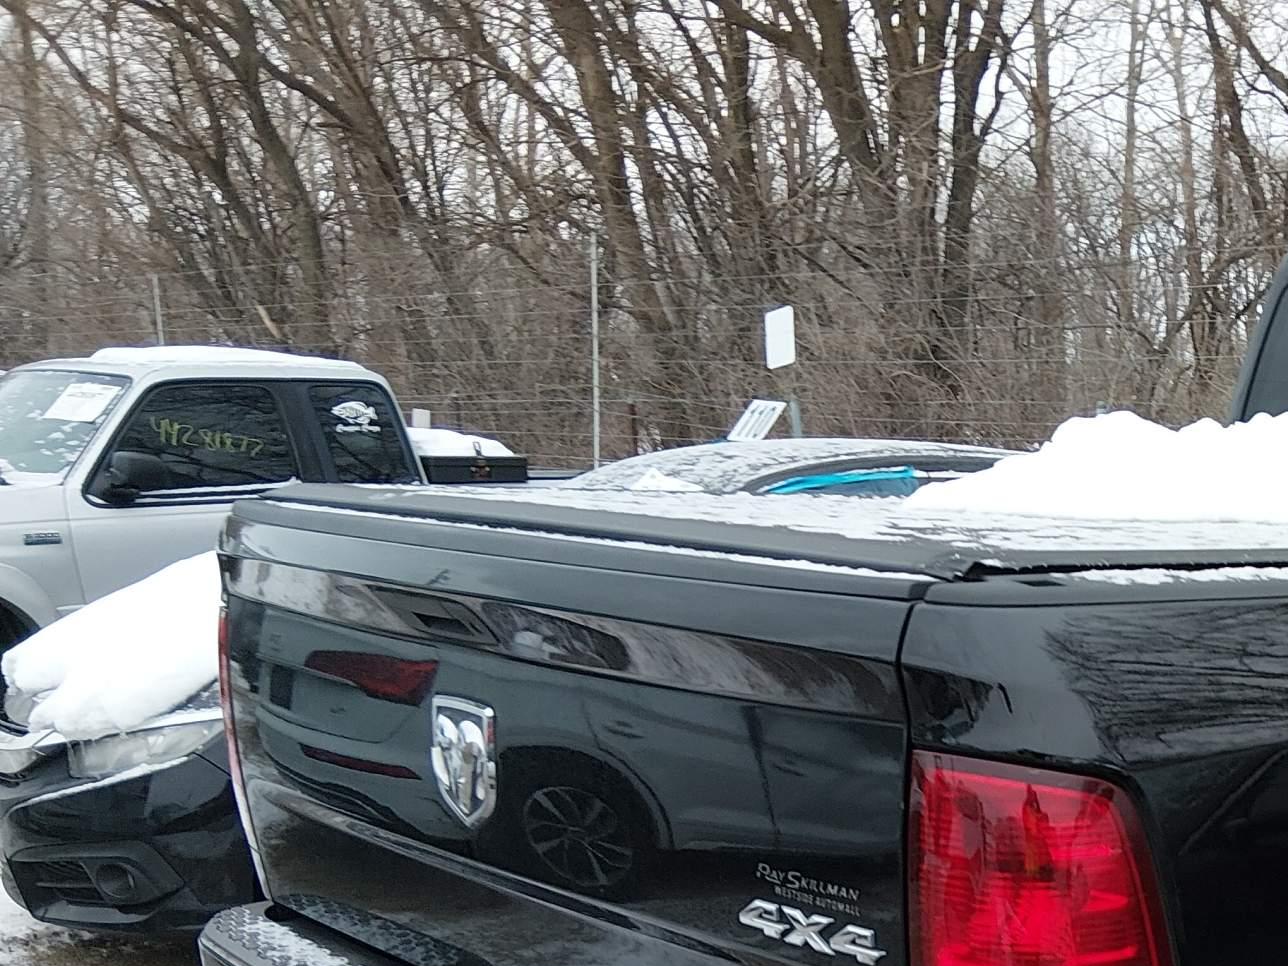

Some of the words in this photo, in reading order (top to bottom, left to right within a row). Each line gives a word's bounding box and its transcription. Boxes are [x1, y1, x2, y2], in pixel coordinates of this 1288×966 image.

[755, 862, 786, 885] RAY
[786, 870, 860, 901] SKILLMAN
[738, 898, 888, 966] 4X4
